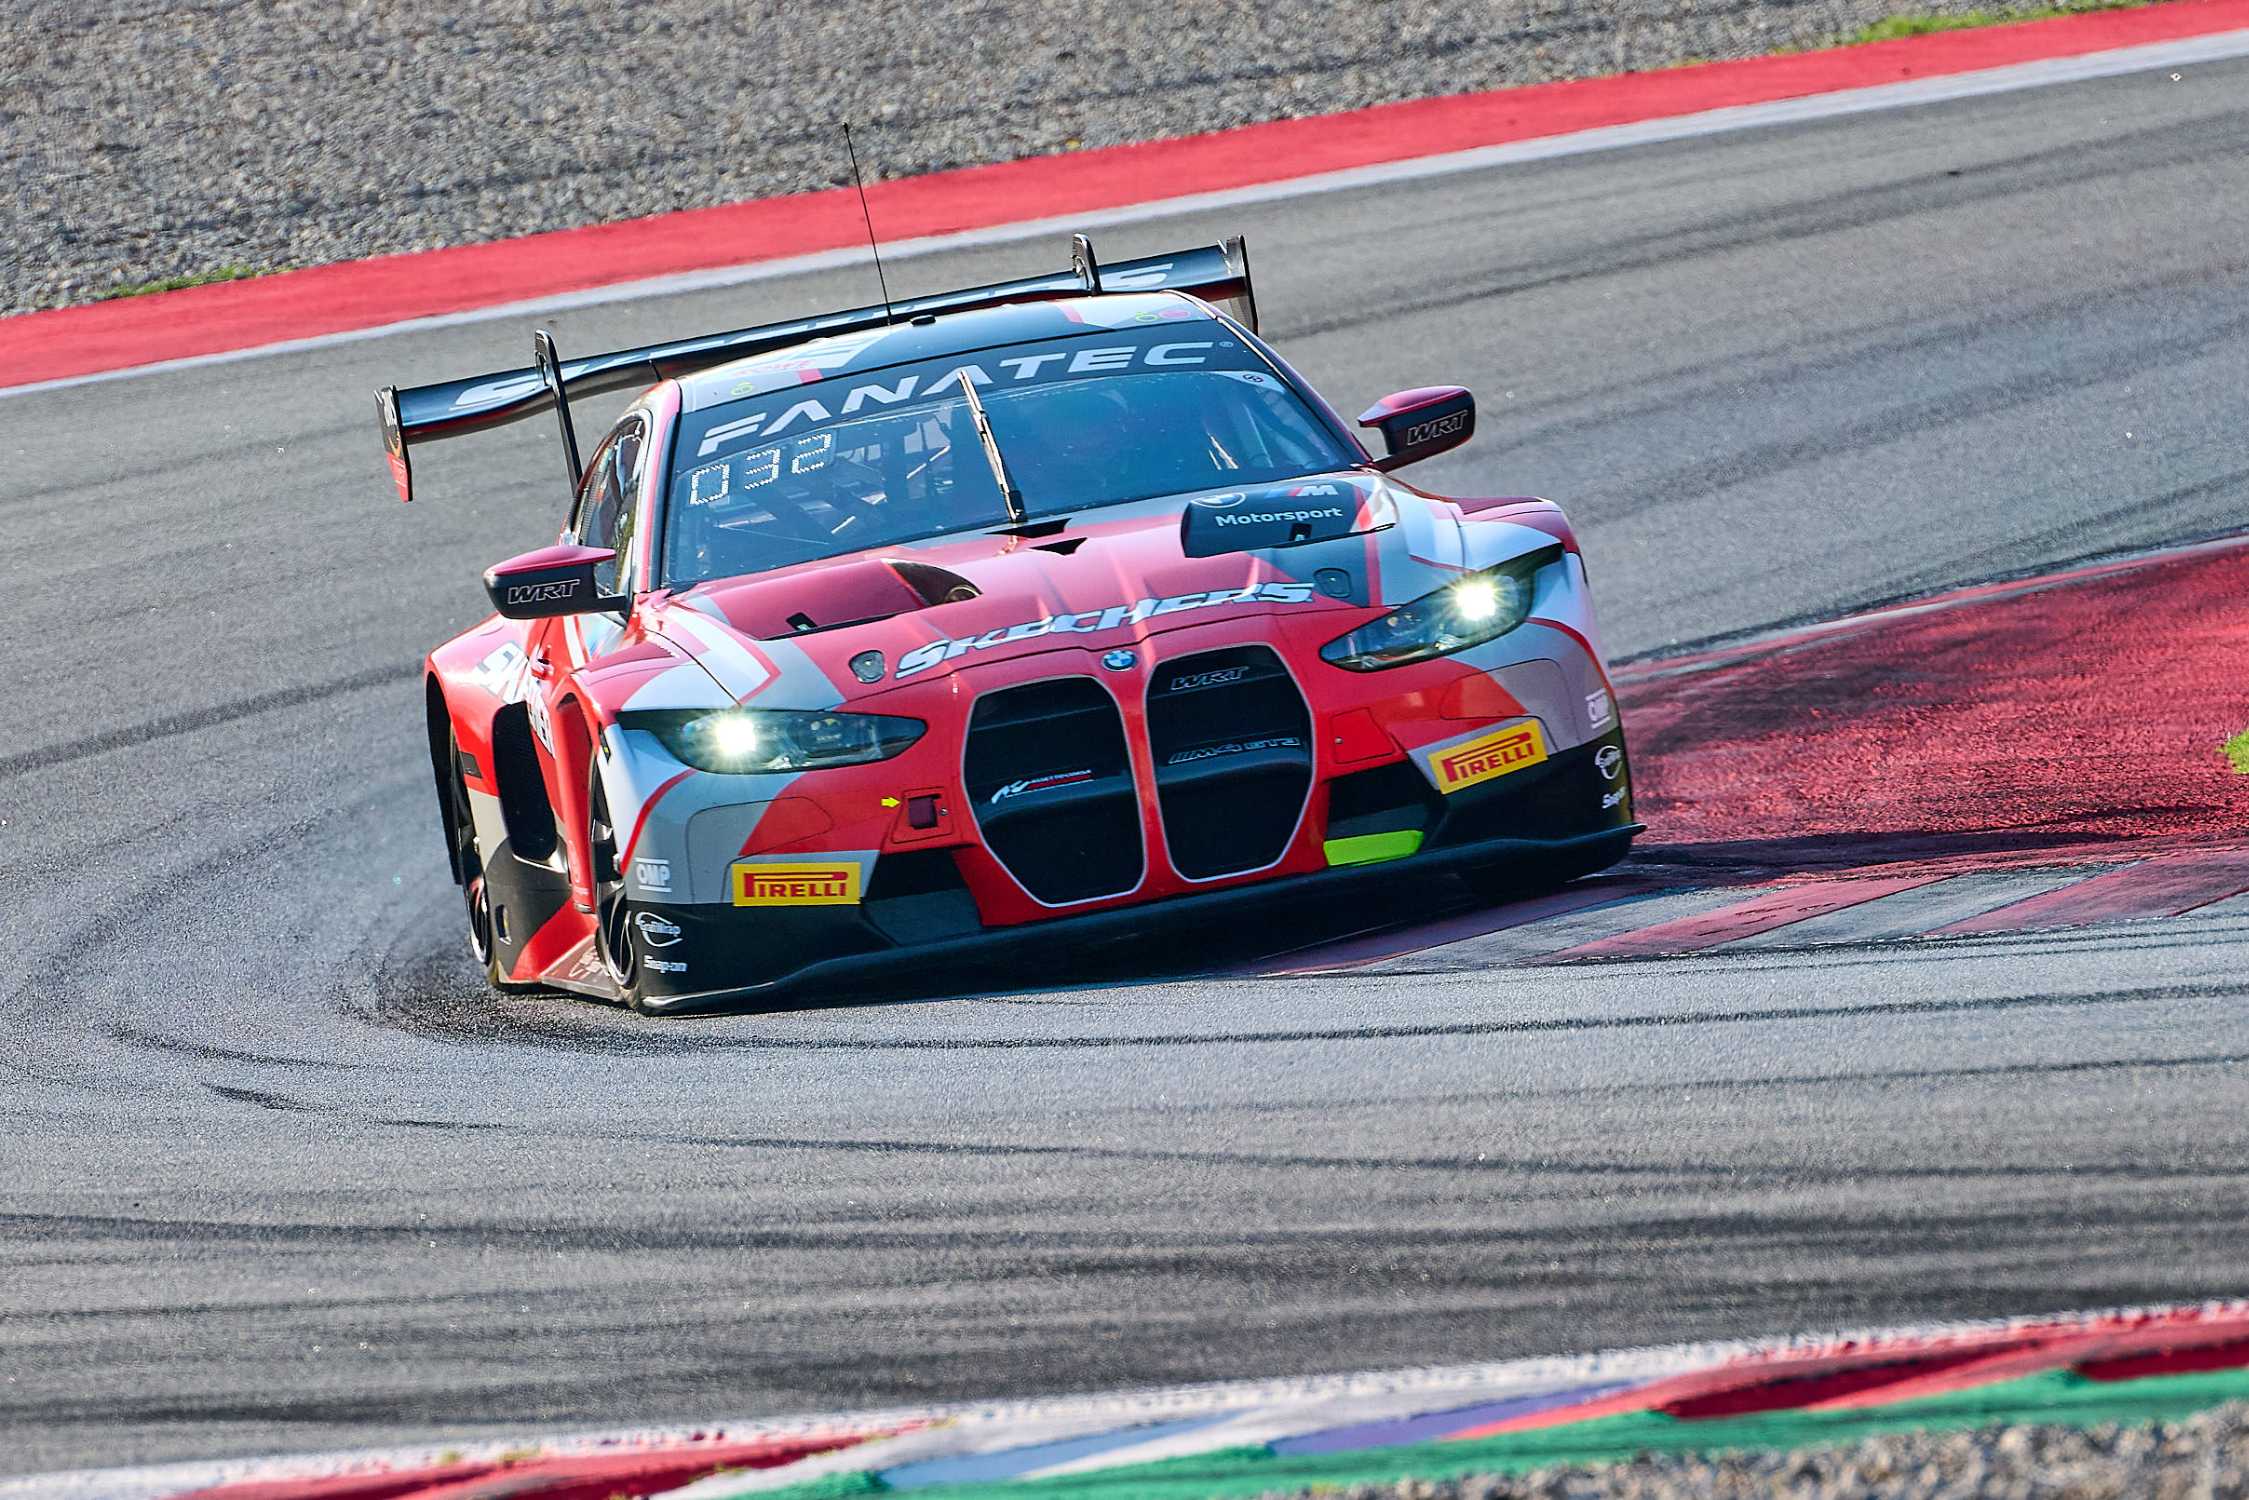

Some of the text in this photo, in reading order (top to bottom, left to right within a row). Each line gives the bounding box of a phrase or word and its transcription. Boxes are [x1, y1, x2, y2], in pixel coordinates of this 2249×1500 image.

[1407, 409, 1468, 446] WRT
[690, 432, 832, 505] 032
[1215, 507, 1344, 527] Motorsport
[507, 578, 581, 605] WRT
[894, 582, 1316, 679] SKECHERS
[1170, 666, 1250, 690] WRT
[1441, 731, 1535, 783] PIRELLI
[743, 871, 849, 898] PIRELLI
